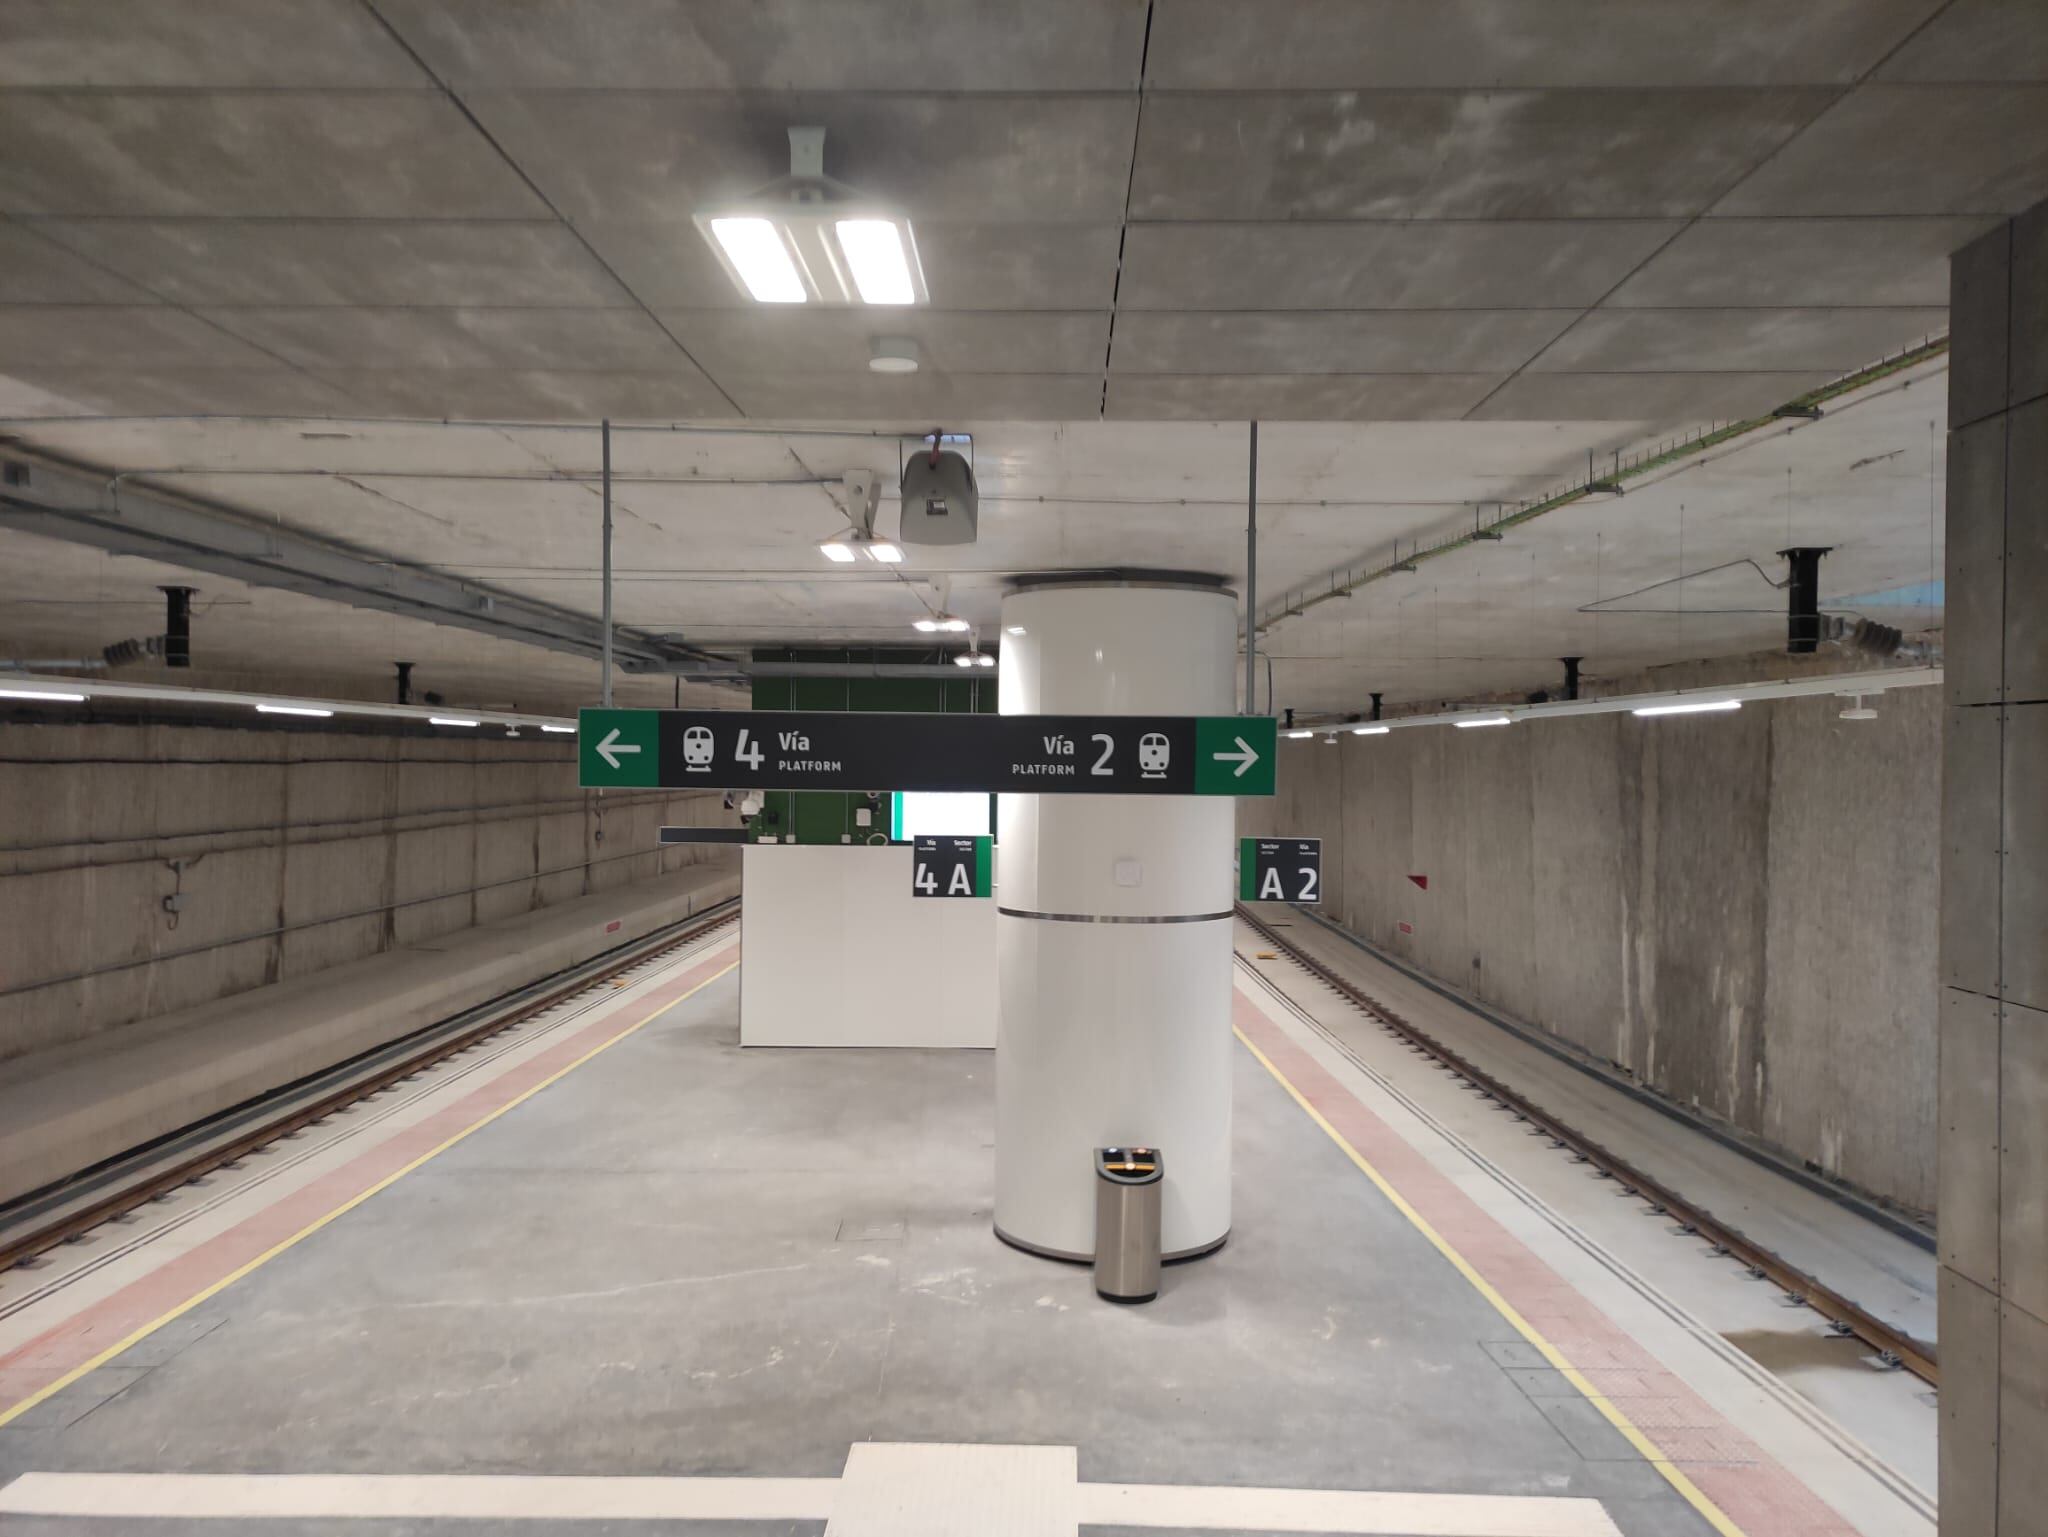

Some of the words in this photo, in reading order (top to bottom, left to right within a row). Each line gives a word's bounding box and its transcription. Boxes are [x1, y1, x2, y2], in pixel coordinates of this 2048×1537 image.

[735, 729, 765, 770] 4
[778, 730, 810, 751] Vía
[778, 760, 842, 771] PLATFORM
[1043, 734, 1075, 755] Vía
[1090, 733, 1114, 775] 2
[1012, 764, 1075, 775] PLATFORM
[915, 863, 938, 895] 4
[948, 863, 972, 895] A
[1260, 867, 1284, 899] A
[1298, 867, 1318, 900] 2
